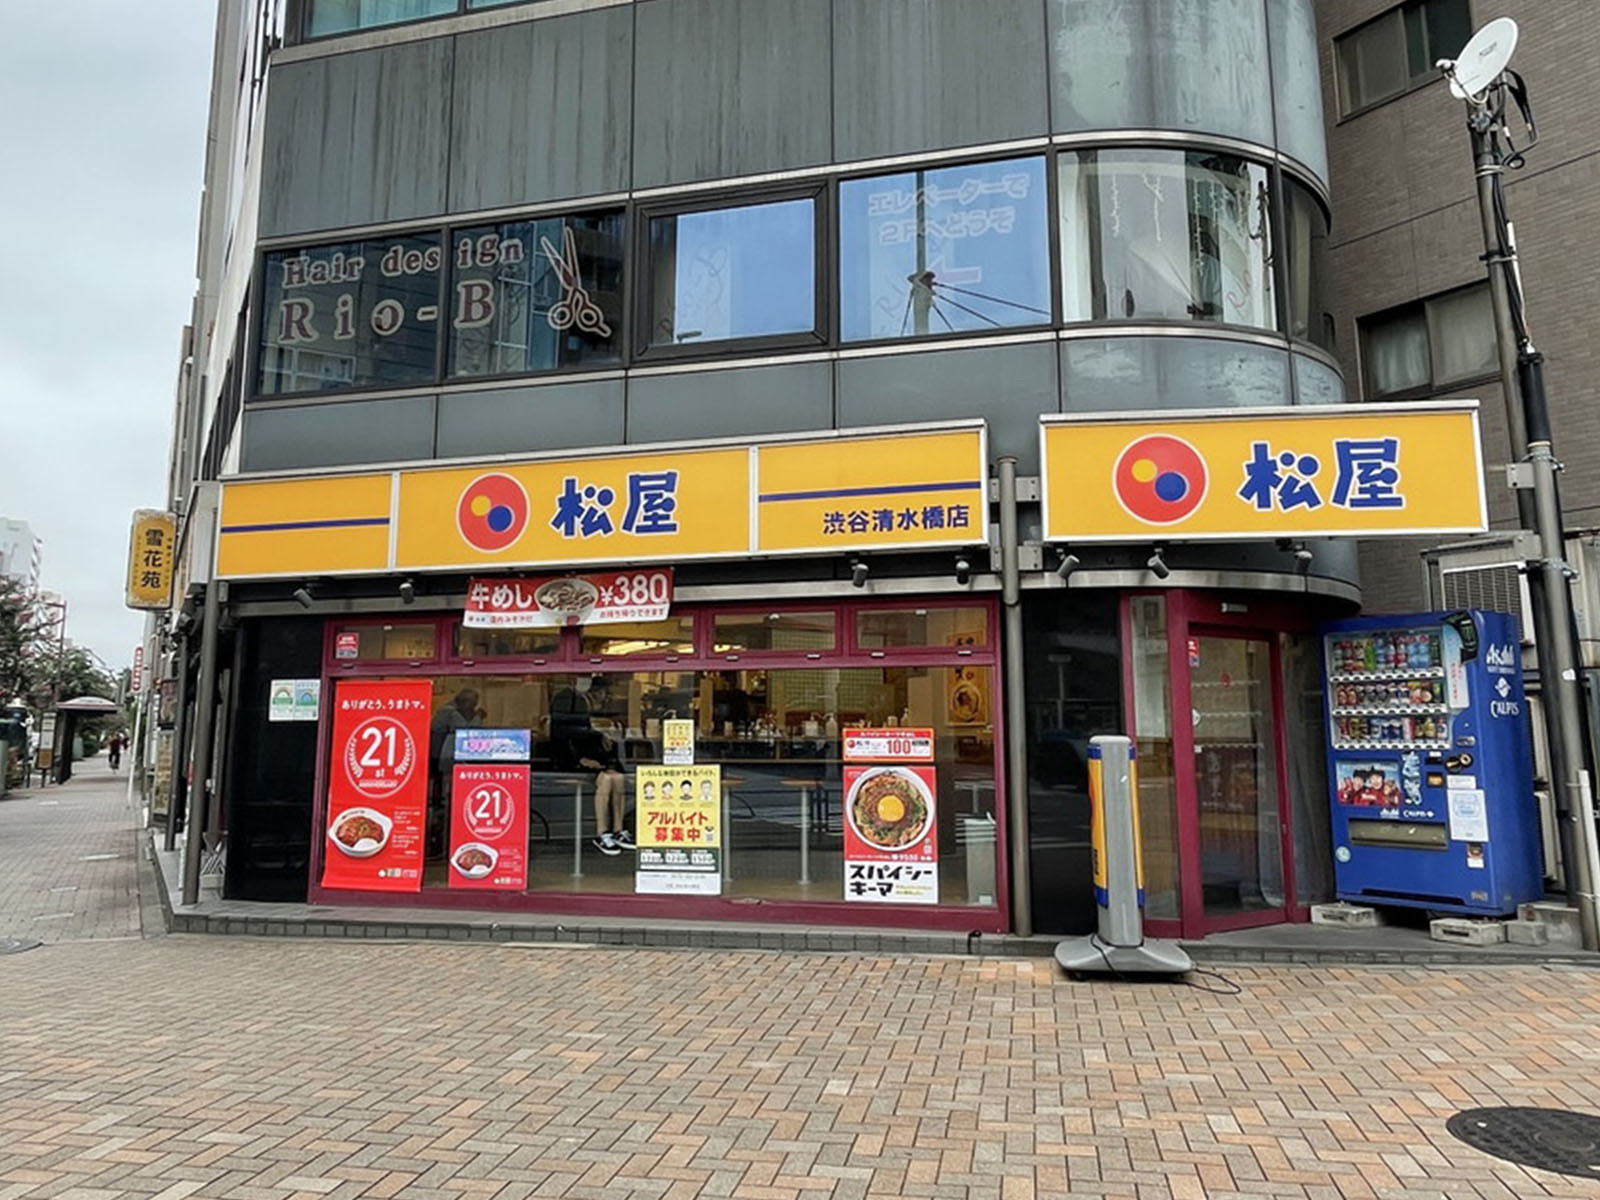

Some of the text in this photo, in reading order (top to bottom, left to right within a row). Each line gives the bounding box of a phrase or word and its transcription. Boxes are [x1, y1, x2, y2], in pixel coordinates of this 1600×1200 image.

[282, 234, 523, 289] Hair design
[1236, 437, 1405, 512] 松屋
[551, 471, 678, 537] 松屋
[821, 504, 970, 535] 渋谷清水橋店
[141, 528, 164, 589] 雪花苑
[470, 573, 668, 609] 牛めし ¥380
[361, 726, 396, 767] 21
[887, 740, 912, 754] 100
[475, 790, 501, 819] 21
[647, 811, 709, 826] アルバイト
[655, 827, 701, 842] 募集中
[849, 864, 932, 880] スパイシー
[849, 882, 893, 897] キーマ
